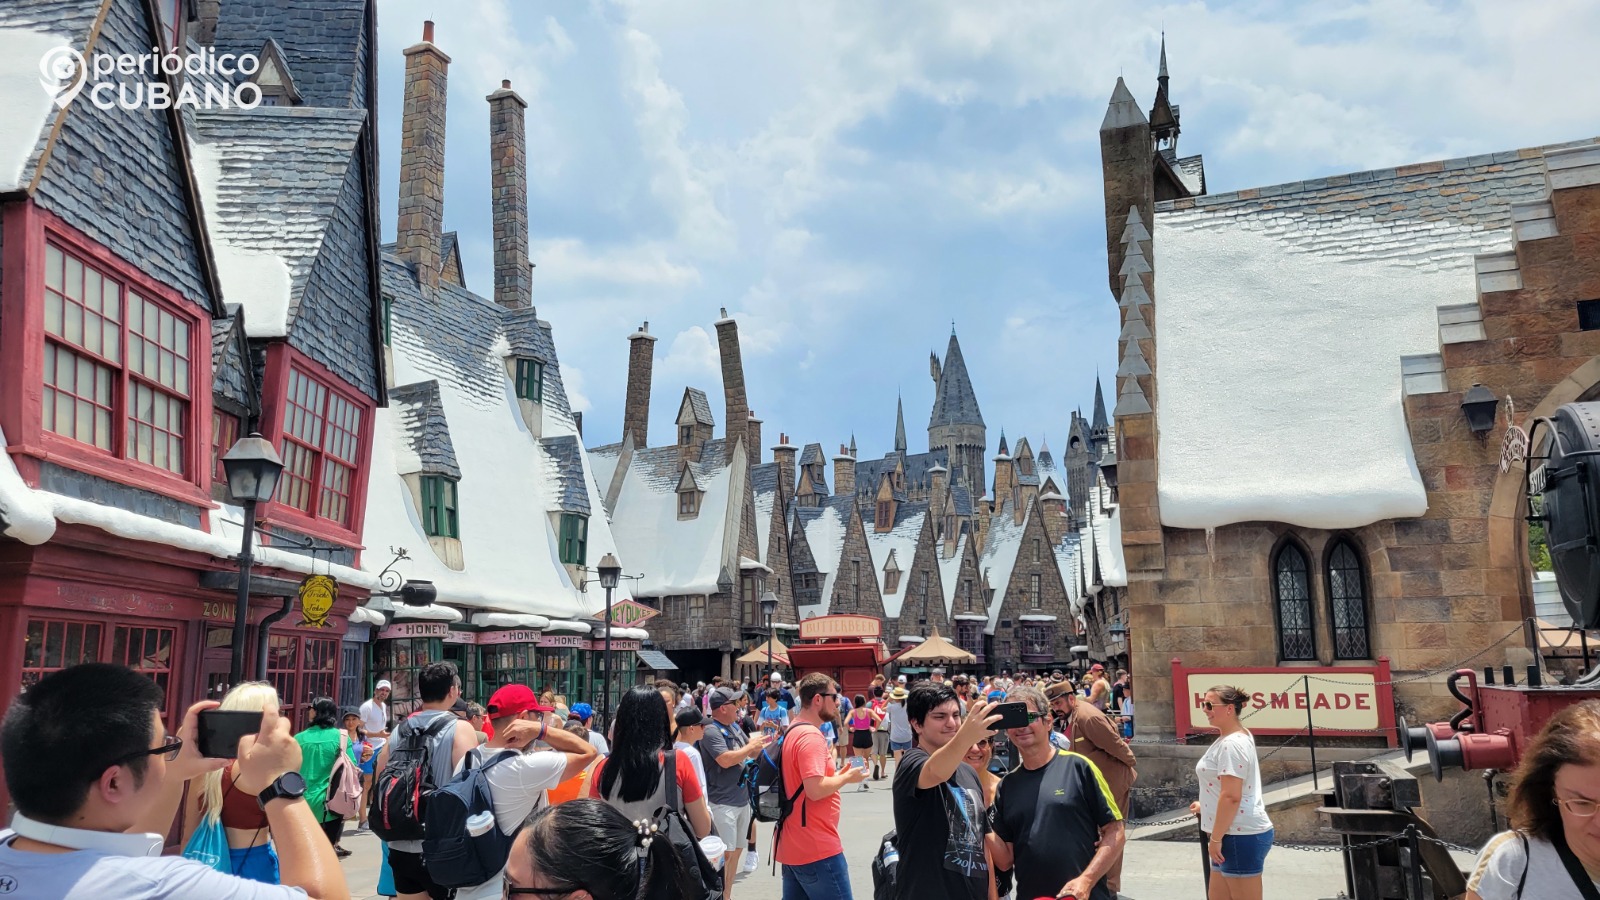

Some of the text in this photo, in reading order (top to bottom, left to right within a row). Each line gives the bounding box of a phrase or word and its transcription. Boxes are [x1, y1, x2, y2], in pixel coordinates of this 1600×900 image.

[406, 624, 448, 635] HONEYD
[806, 620, 875, 633] BUTTERBEER
[1195, 692, 1371, 710] HSMEADE
